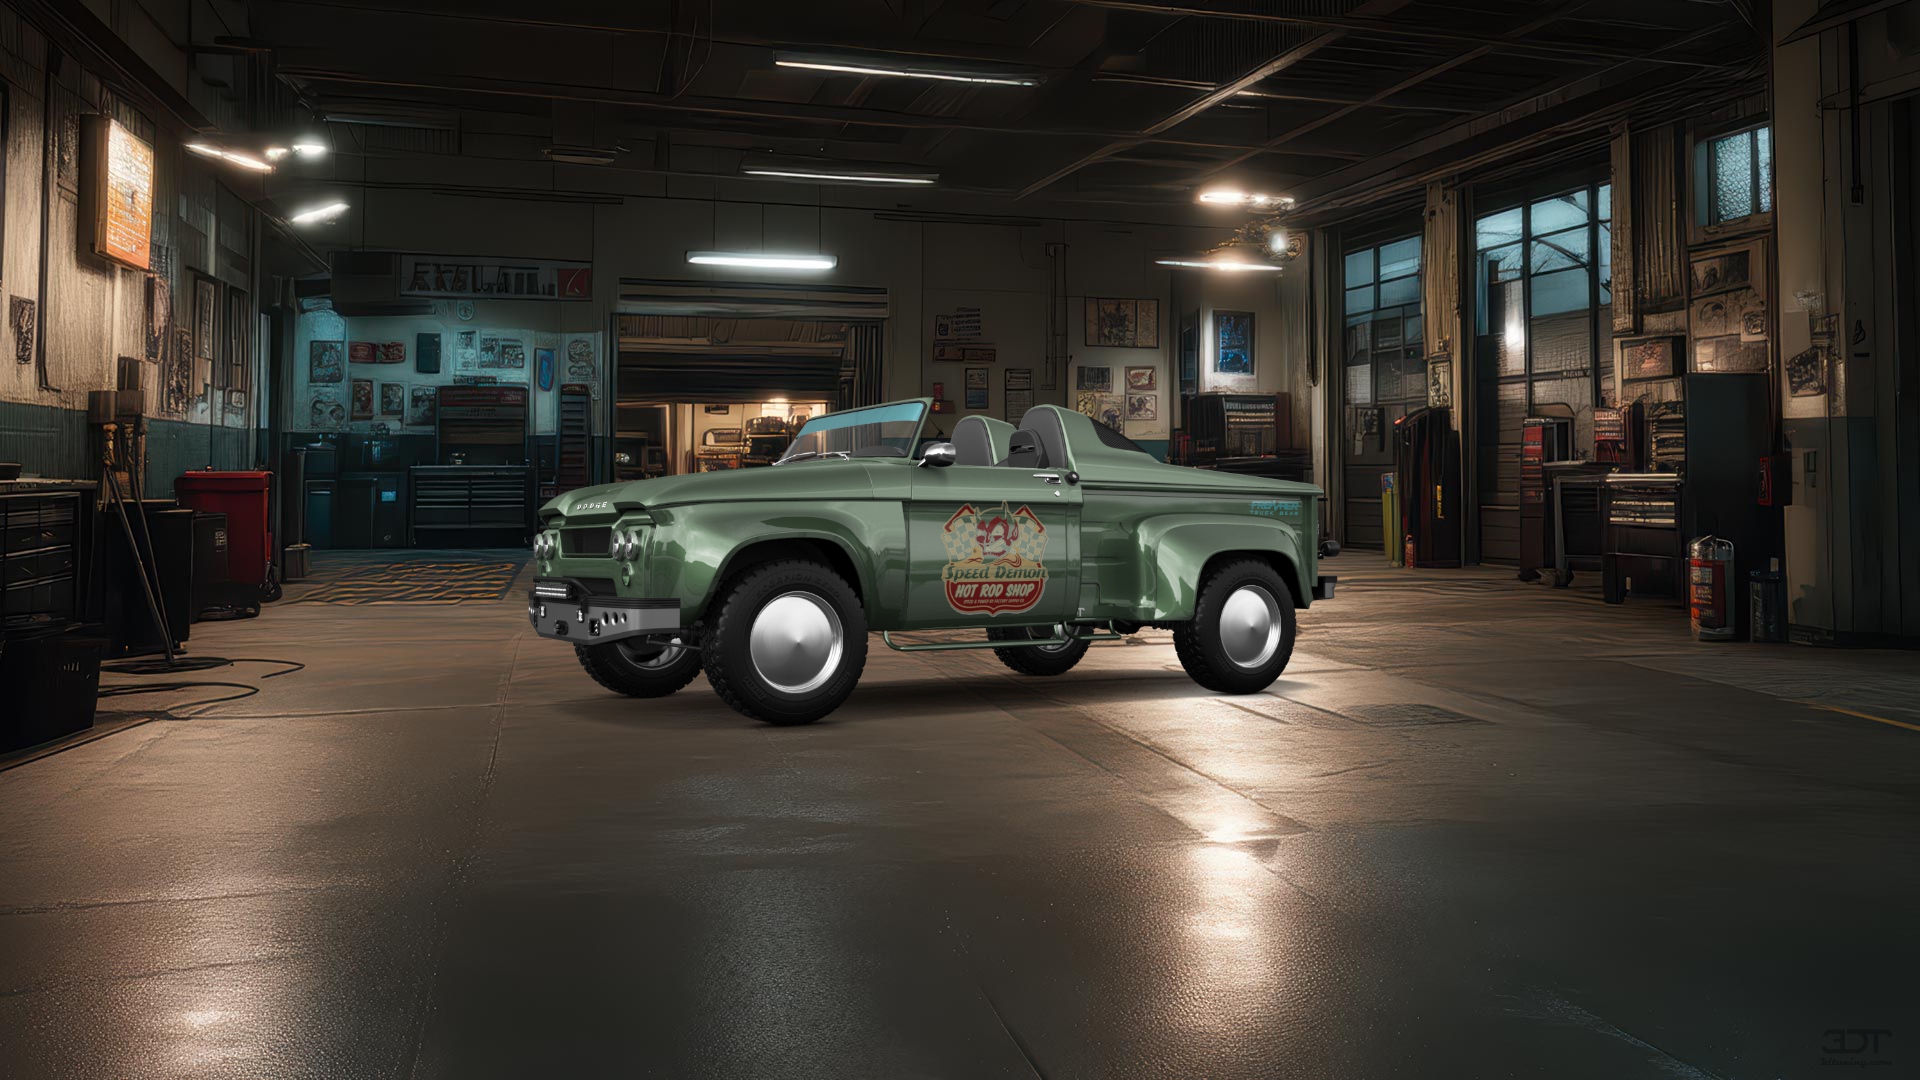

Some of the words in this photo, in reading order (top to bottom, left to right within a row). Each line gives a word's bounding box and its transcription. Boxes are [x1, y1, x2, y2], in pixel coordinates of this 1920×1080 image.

[576, 501, 608, 510] DODGE
[994, 566, 1047, 579] Demon
[955, 584, 979, 598] HOT
[980, 584, 1004, 598] ROD
[1005, 583, 1035, 597] SHOP
